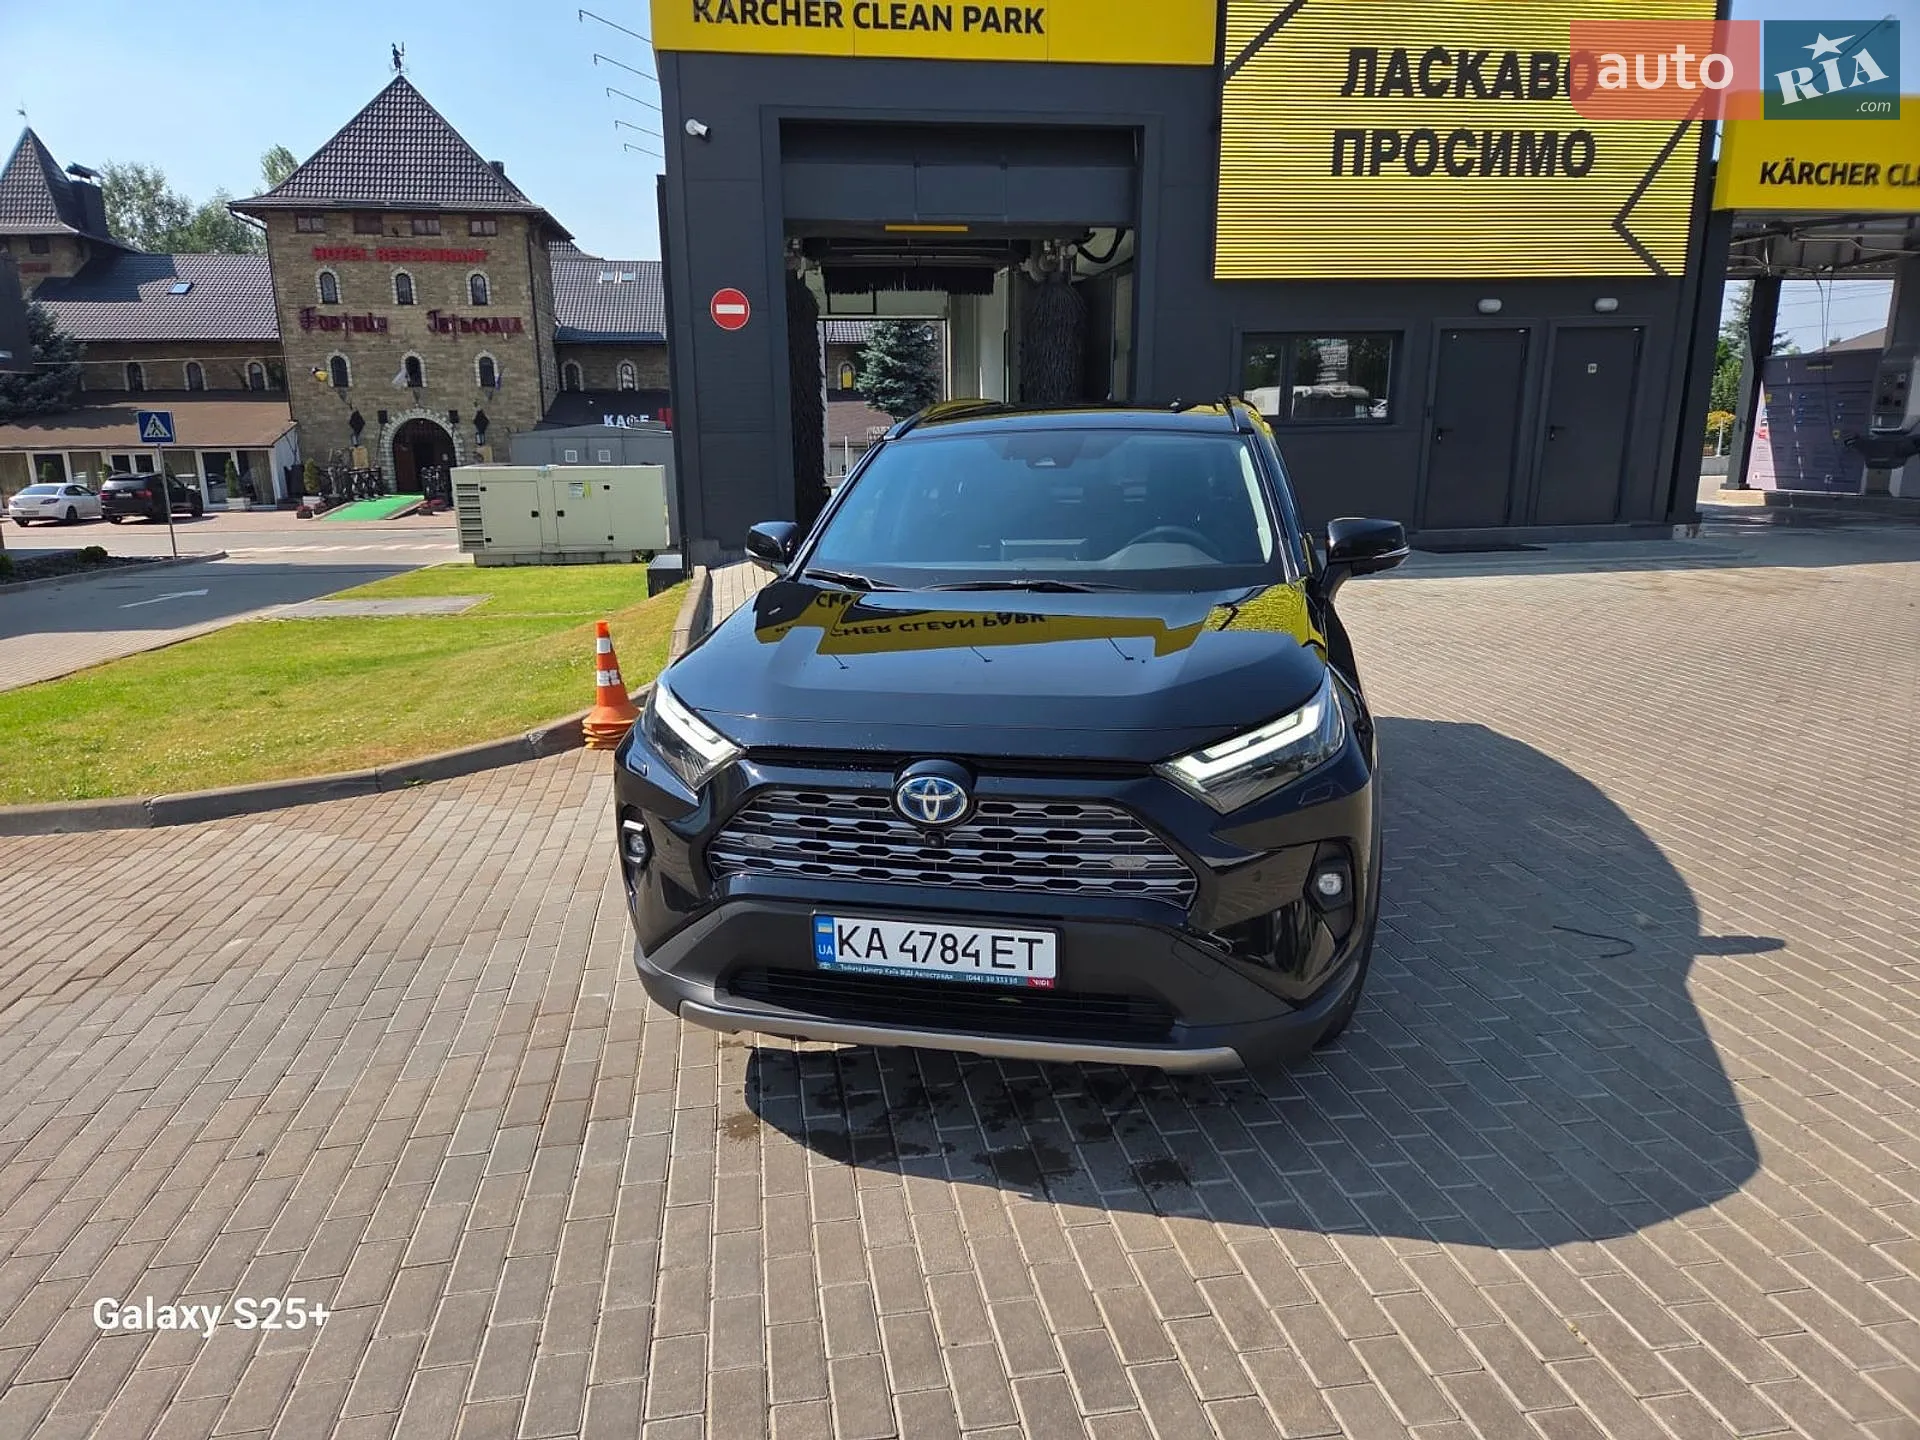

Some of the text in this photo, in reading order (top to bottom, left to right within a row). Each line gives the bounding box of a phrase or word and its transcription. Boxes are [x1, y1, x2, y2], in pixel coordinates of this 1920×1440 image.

[853, 2, 952, 32] CLEAN
[962, 5, 1045, 34] PARK
[1340, 46, 1599, 100] ЛАСКАВО
[1331, 127, 1597, 178] ПРОСИМО
[1759, 157, 1881, 186] KÄRCHER
[818, 944, 834, 956] UA
[837, 924, 1044, 971] KA 4784 ET
